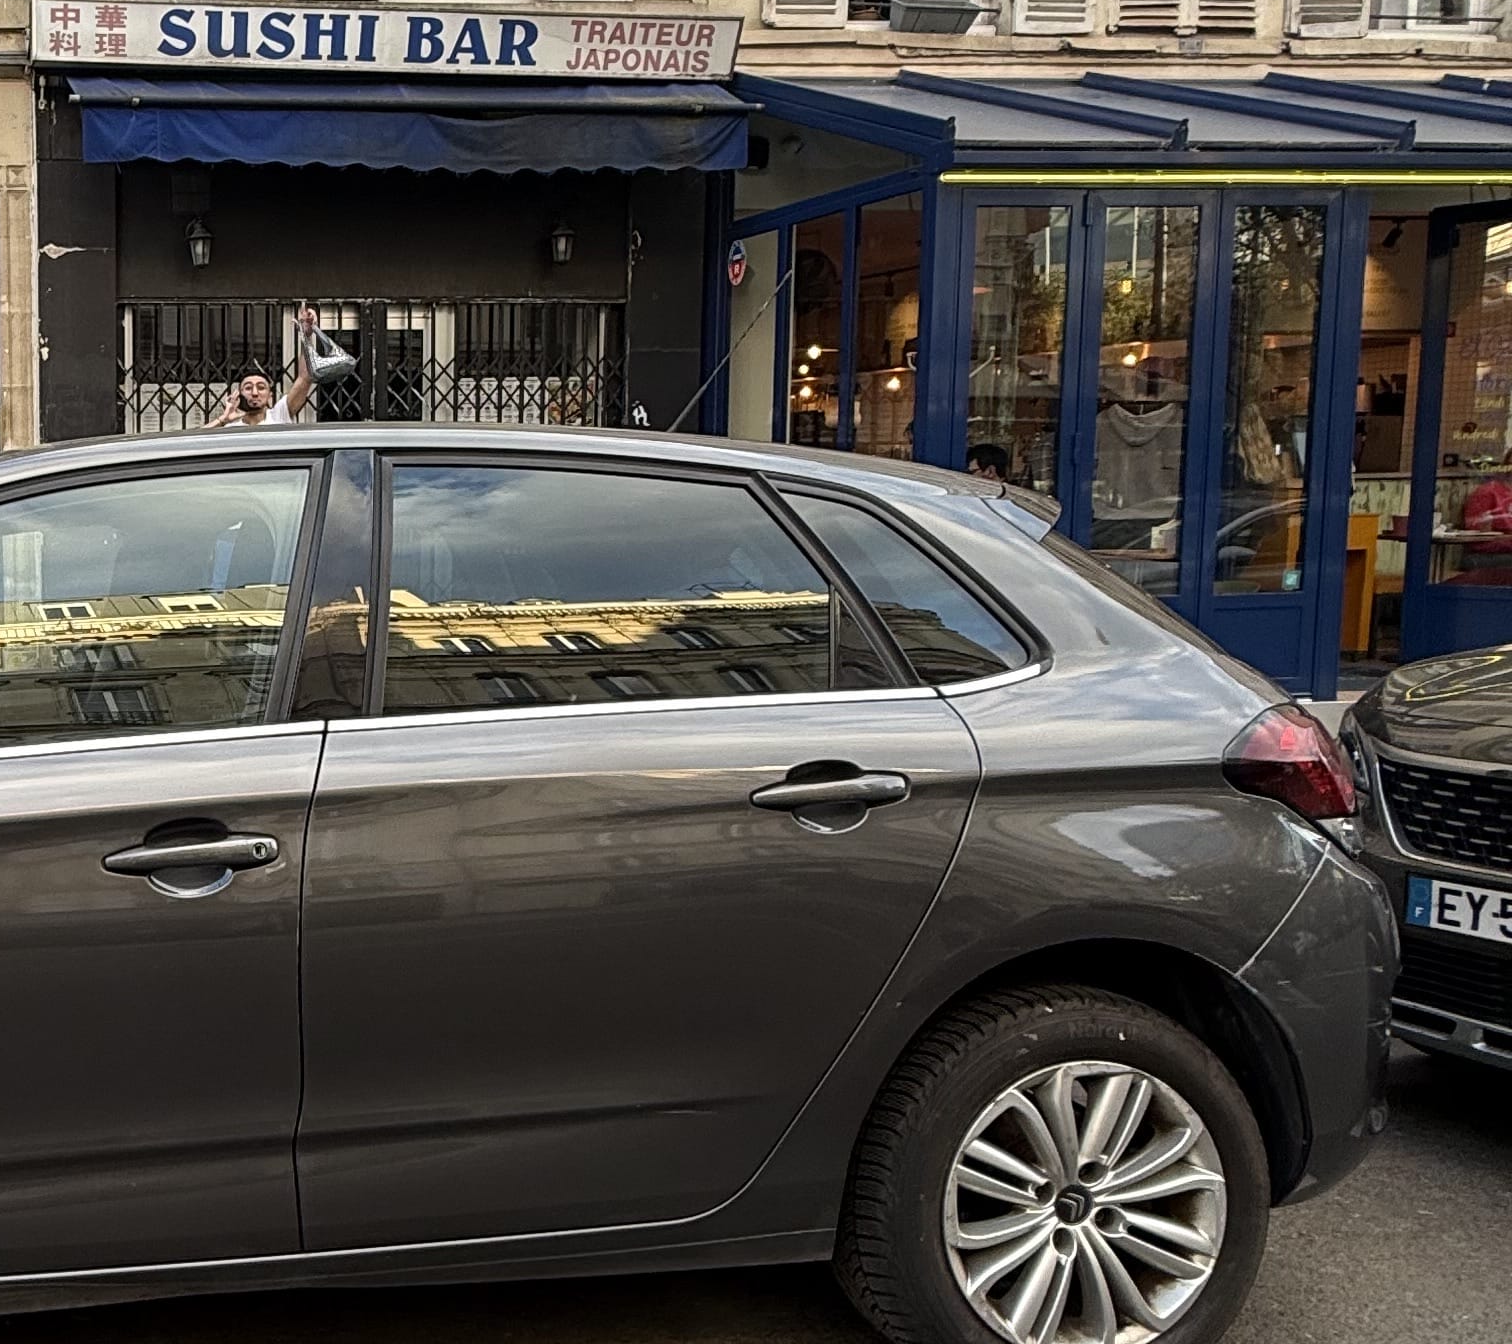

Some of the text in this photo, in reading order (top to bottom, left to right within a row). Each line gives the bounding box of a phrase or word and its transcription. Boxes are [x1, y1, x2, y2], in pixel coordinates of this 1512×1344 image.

[157, 8, 539, 67] SUSHI BAR
[570, 19, 717, 48] TRAITEUR
[566, 47, 710, 74] JAPONAIS
[1414, 907, 1425, 918] F
